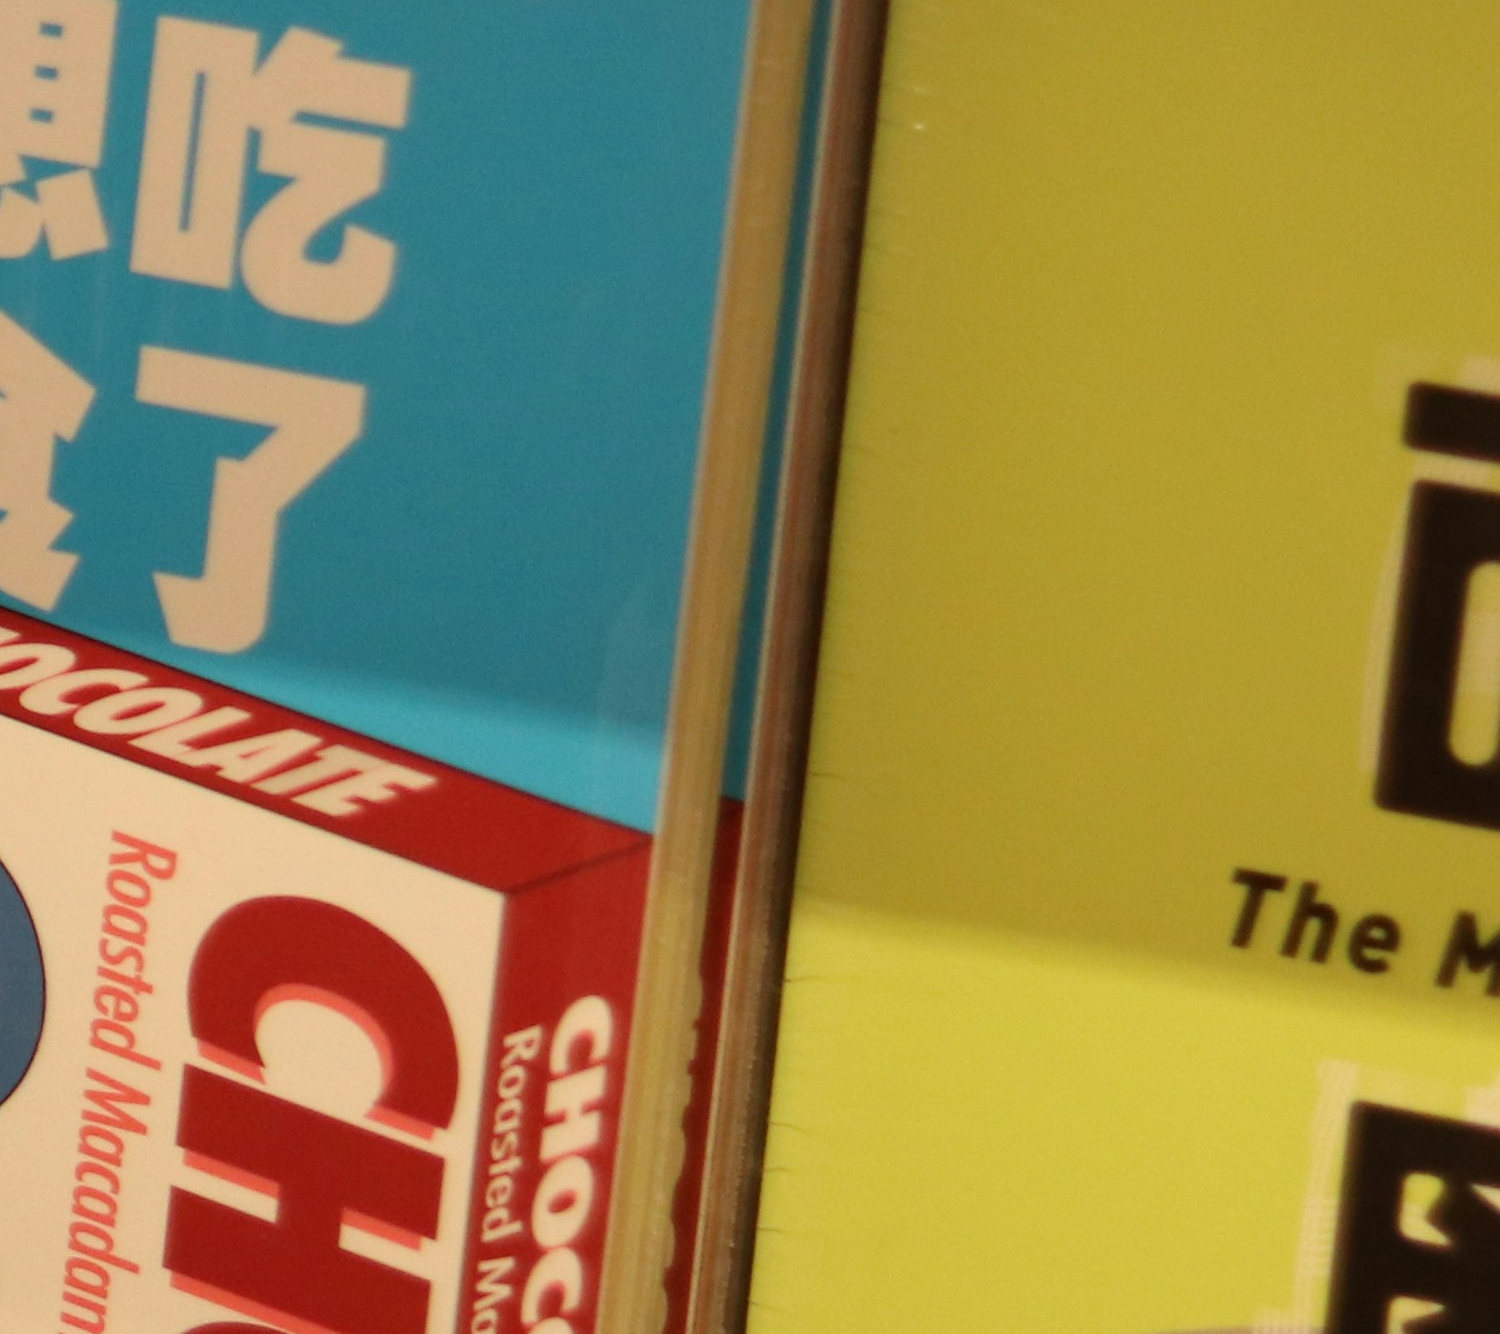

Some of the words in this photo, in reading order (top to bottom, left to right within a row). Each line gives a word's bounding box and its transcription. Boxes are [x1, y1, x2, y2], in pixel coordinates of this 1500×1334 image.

[90, 829, 178, 1069] Roasted
[1229, 866, 1401, 974] The
[480, 1025, 543, 1244] Roasted
